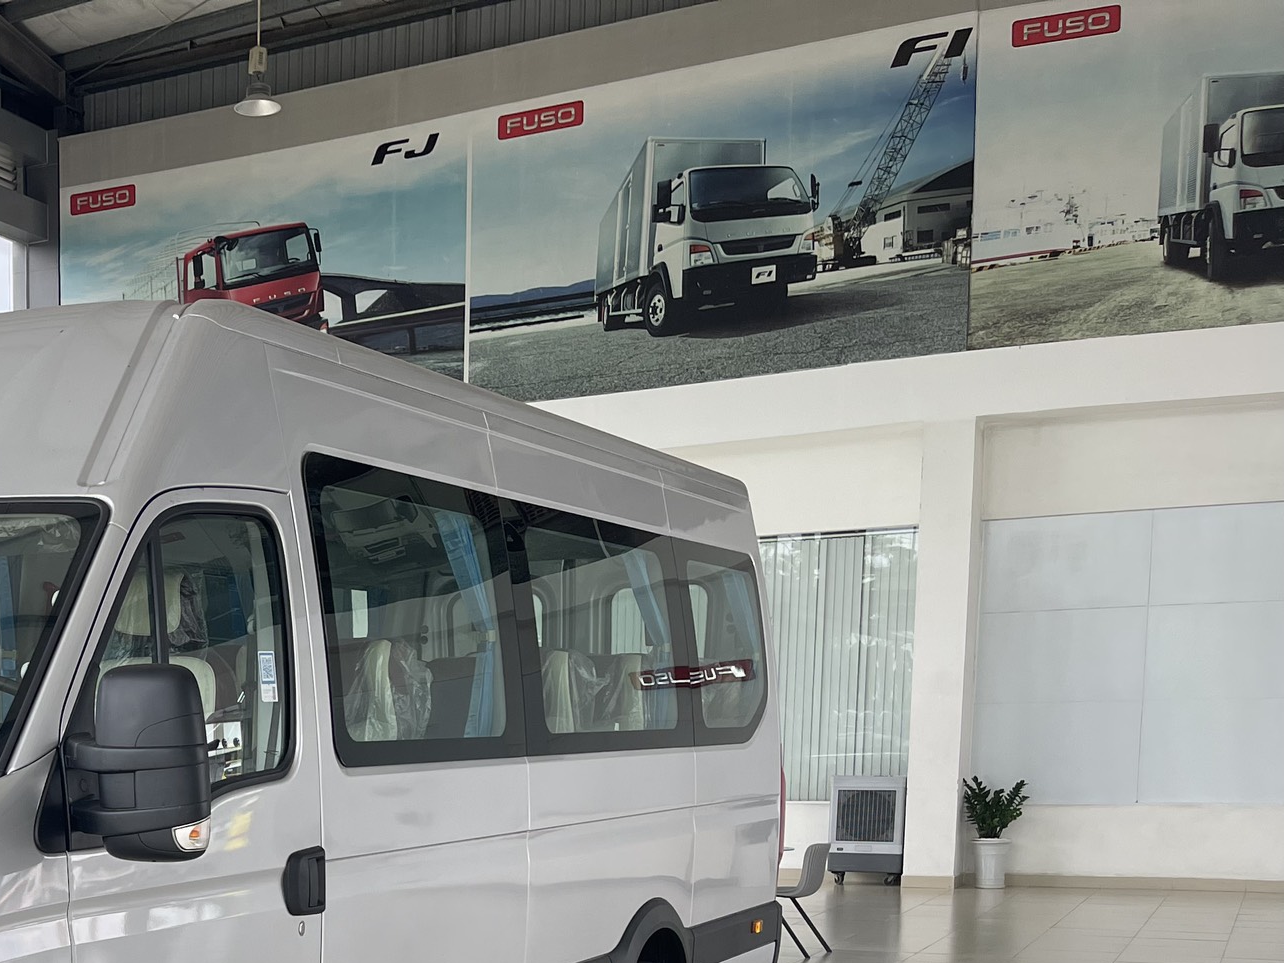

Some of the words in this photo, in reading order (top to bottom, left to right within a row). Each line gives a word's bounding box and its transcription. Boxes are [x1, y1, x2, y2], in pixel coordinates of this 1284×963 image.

[1022, 11, 1111, 41] FUSO
[890, 26, 974, 69] FI
[506, 106, 576, 135] FUSO
[370, 132, 440, 166] FJ
[76, 189, 130, 211] FUSO
